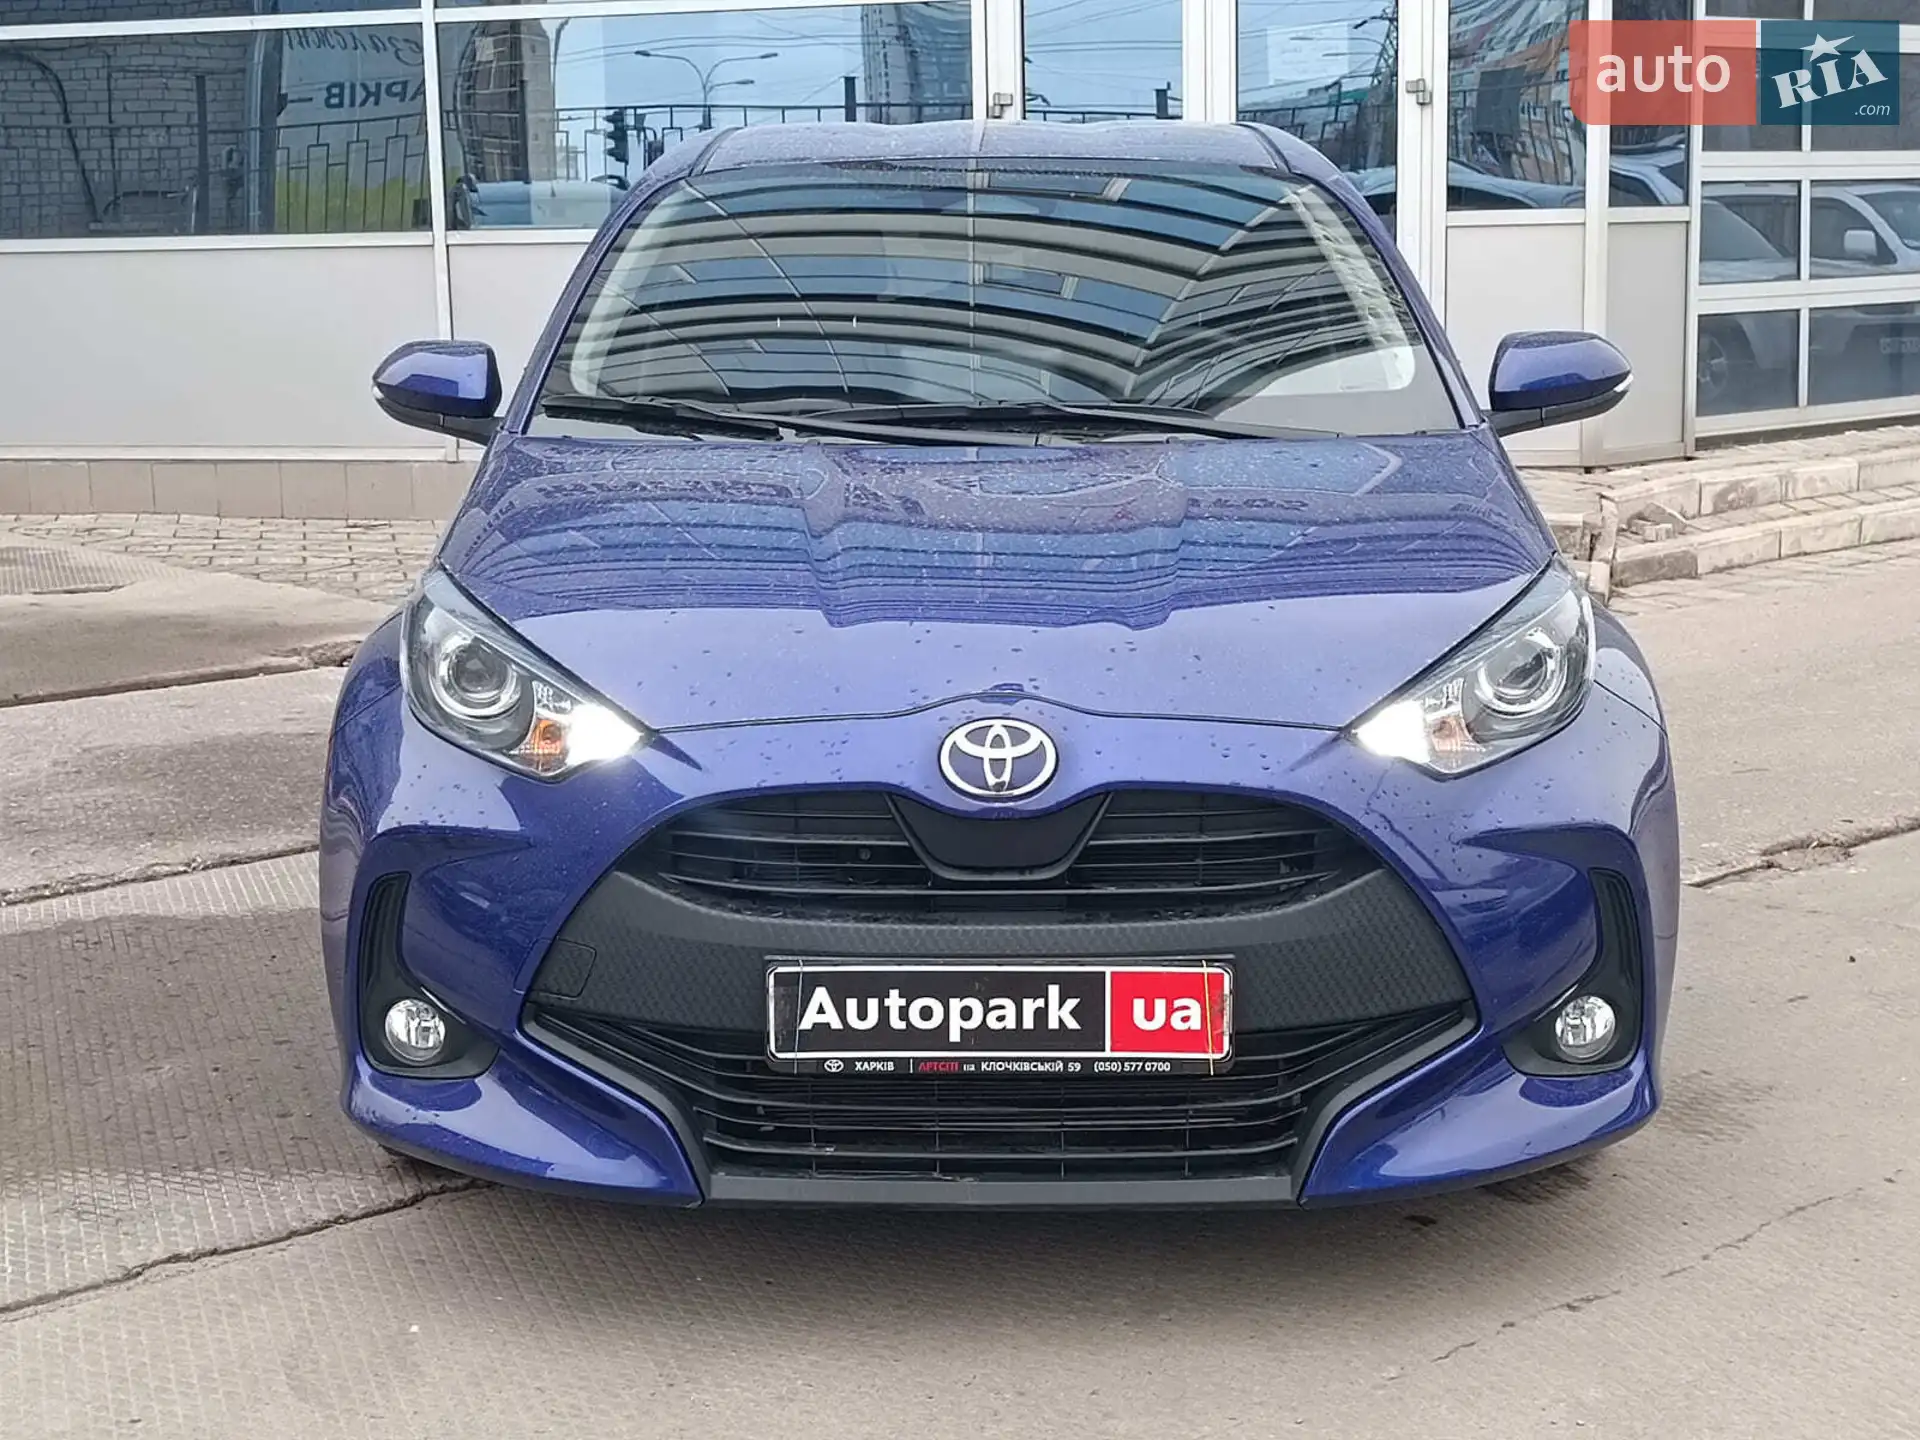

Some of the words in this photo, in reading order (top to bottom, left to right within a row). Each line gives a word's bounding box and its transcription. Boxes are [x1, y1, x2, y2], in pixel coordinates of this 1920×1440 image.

[797, 985, 1082, 1042] Autopark
[1131, 996, 1203, 1031] ua
[854, 1060, 895, 1072] ХАРКІВ
[980, 1060, 1064, 1073] КЛОЧКІВСЬКІЙ
[1067, 1061, 1082, 1073] 59
[1093, 1060, 1122, 1073] (050)
[1123, 1061, 1143, 1072] 577
[1144, 1061, 1171, 1072] 0700
